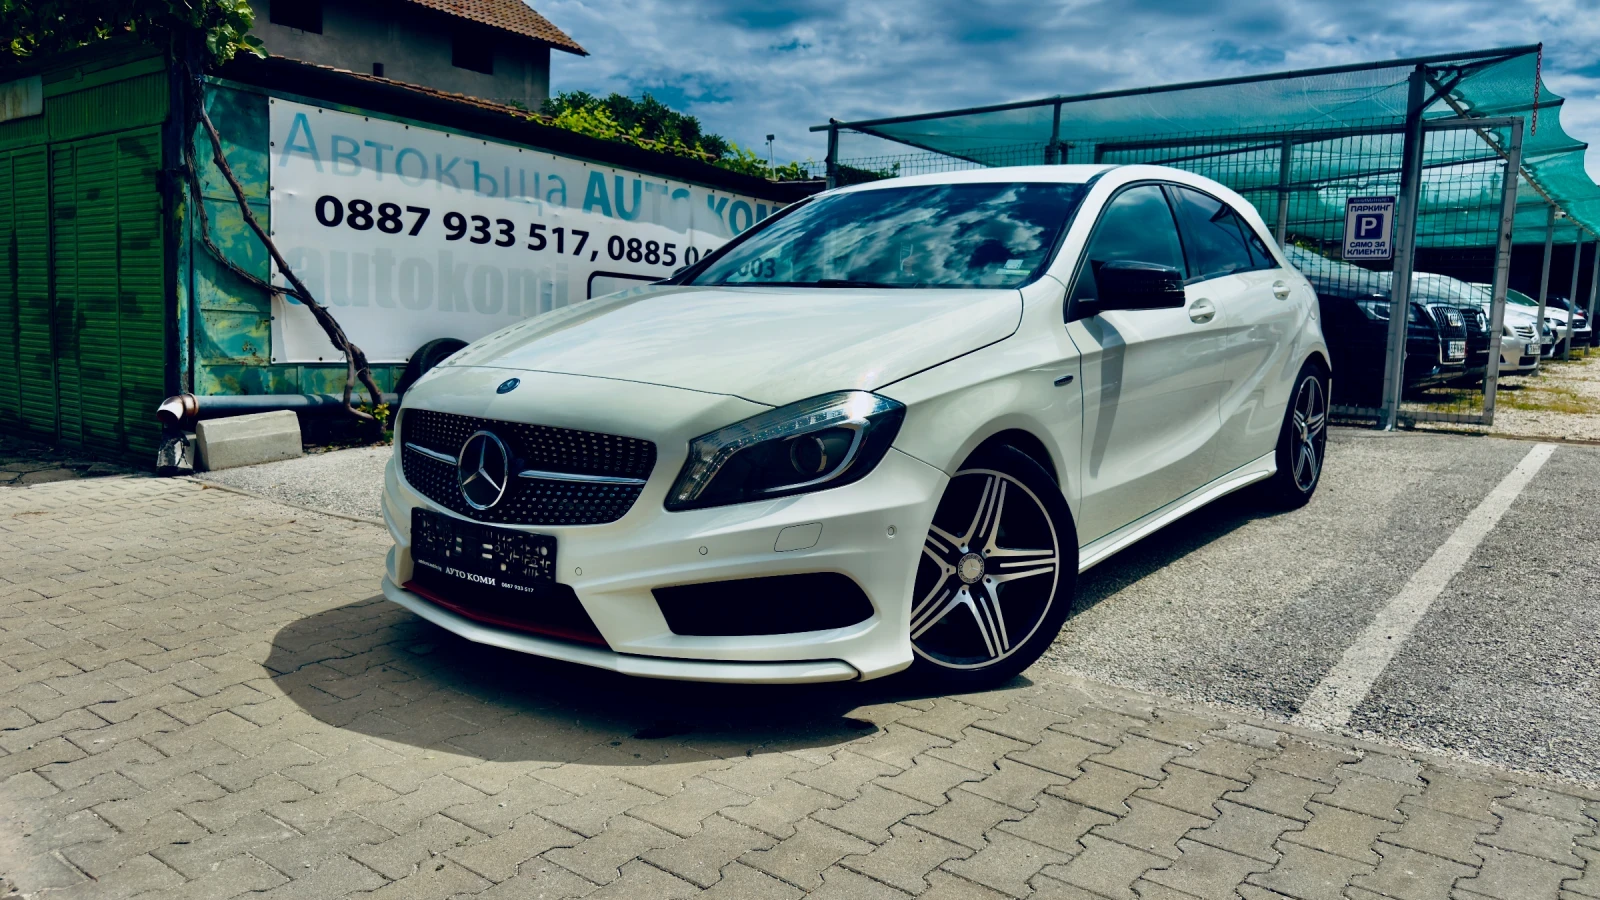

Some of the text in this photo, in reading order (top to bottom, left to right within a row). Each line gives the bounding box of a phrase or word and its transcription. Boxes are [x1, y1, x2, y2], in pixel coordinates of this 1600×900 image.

[278, 112, 568, 217] Автокъща
[314, 194, 431, 236] 0887
[442, 211, 516, 248] 933
[527, 223, 599, 262] 517,
[607, 235, 677, 266] 0885
[1360, 218, 1377, 236] P
[284, 244, 569, 317] autokomi
[467, 573, 496, 586] КОМИ
